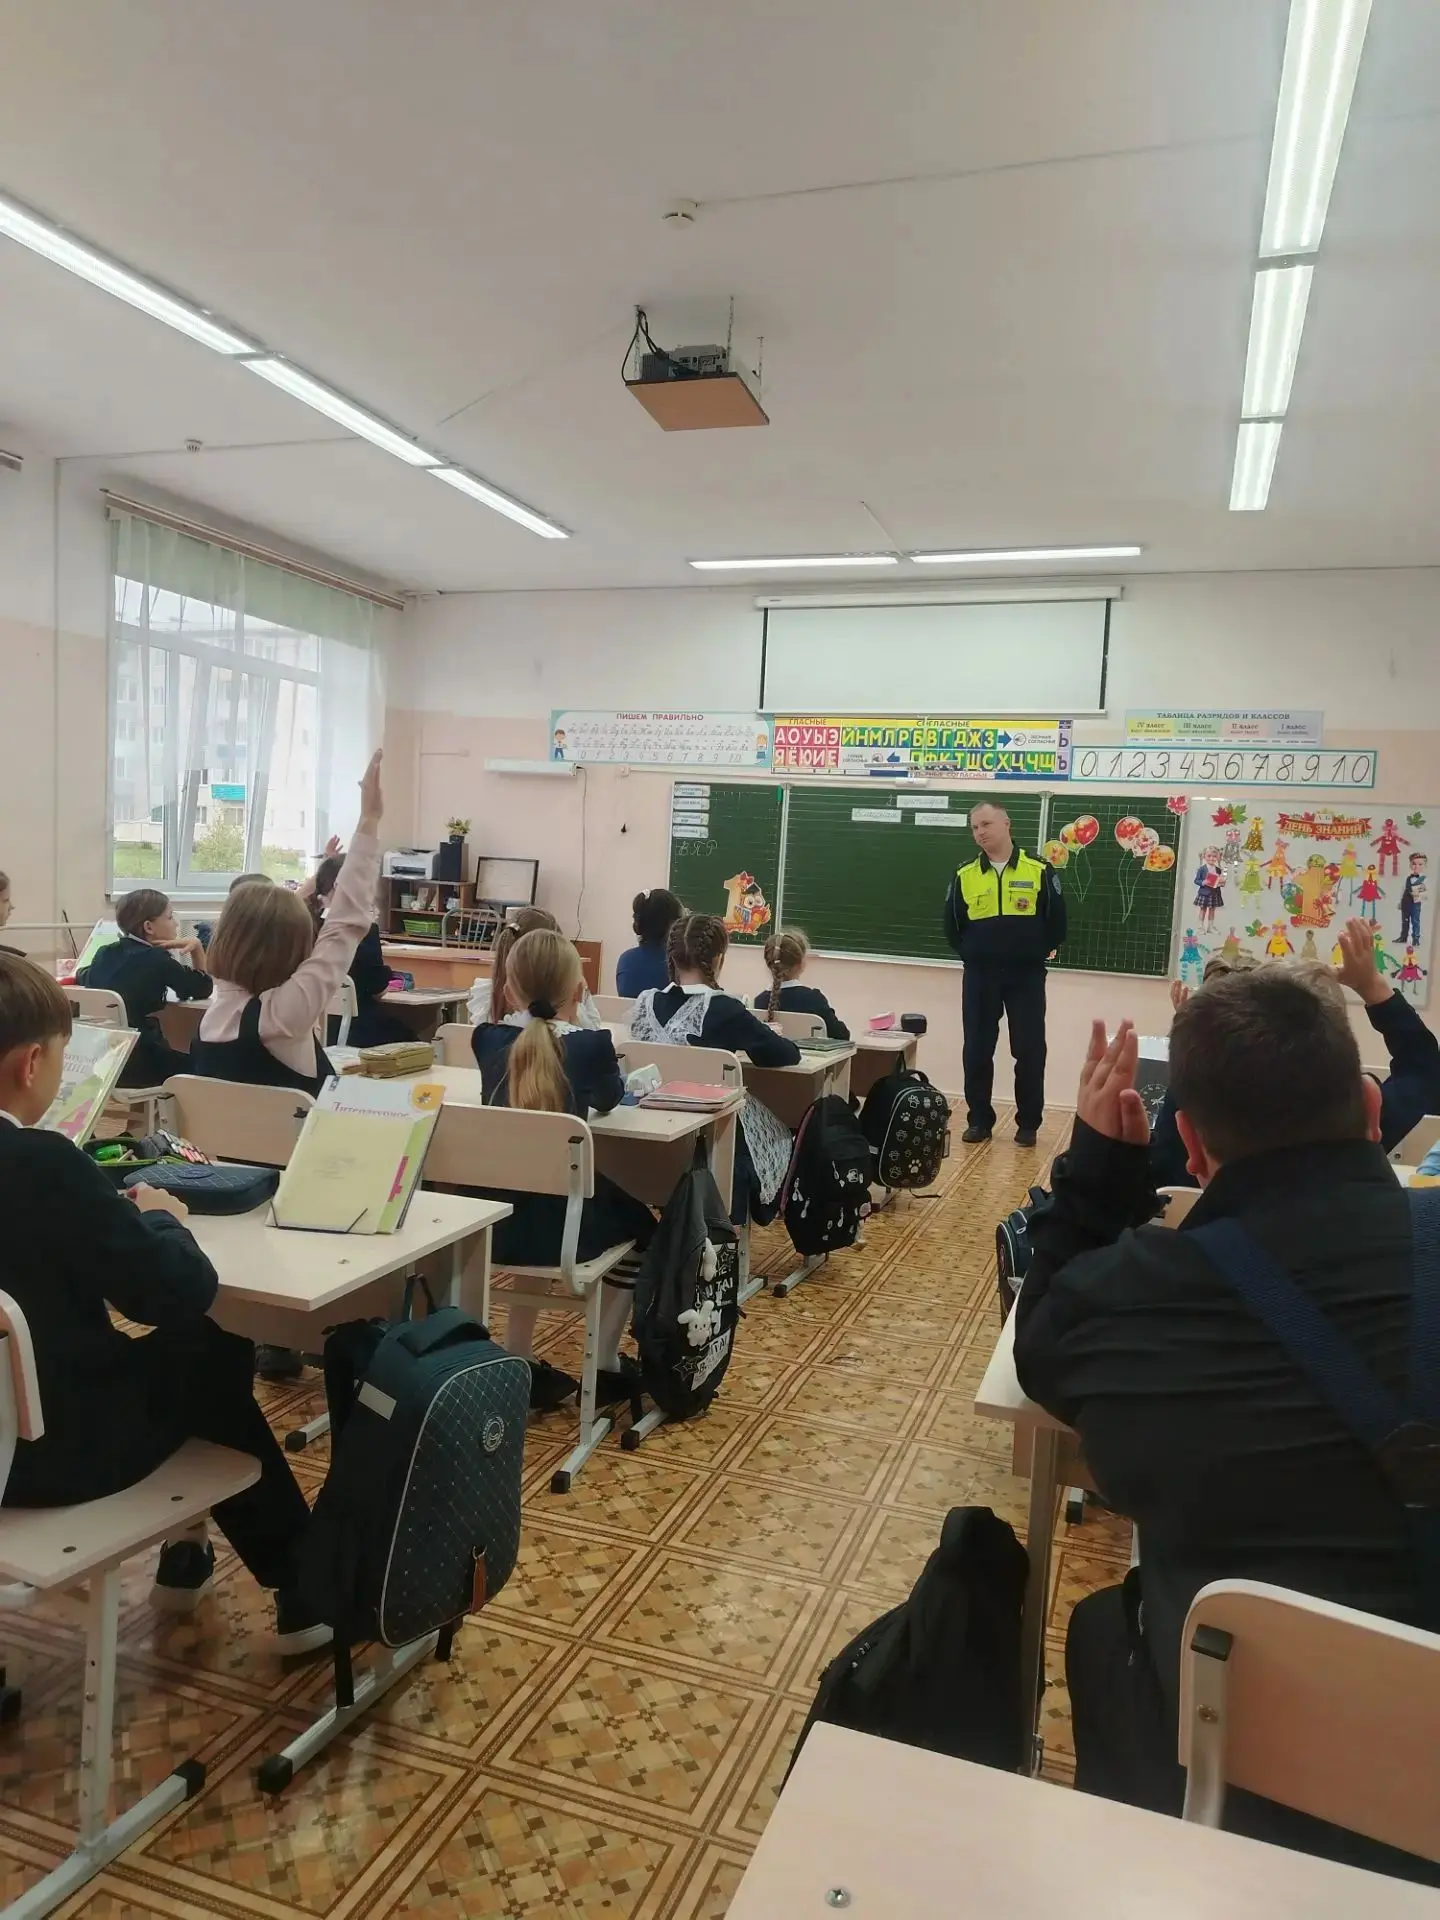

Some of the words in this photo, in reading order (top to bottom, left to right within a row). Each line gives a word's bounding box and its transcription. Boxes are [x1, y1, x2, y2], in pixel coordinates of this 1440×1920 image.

[616, 712, 648, 721] ПИШЕМ
[652, 712, 704, 722] ПРАВИЛЬНО
[1196, 713, 1240, 721] РАЗРЯДОВ
[789, 718, 827, 726] ГЛАСНЫЕ
[916, 720, 970, 728] СОГЛАСНЫЕ
[1080, 750, 1096, 777] 0
[1109, 751, 1122, 776] 1
[1127, 751, 1146, 778] 2
[1150, 752, 1169, 778] 3
[1179, 752, 1193, 779] 4
[1198, 754, 1219, 779] 5
[1224, 752, 1243, 780] 6
[1251, 753, 1269, 780] 7
[1275, 753, 1294, 781] 8
[1301, 754, 1319, 781] 9
[1284, 820, 1313, 833] ДЕНЬ
[1315, 822, 1363, 834] ЗНАНИЙ
